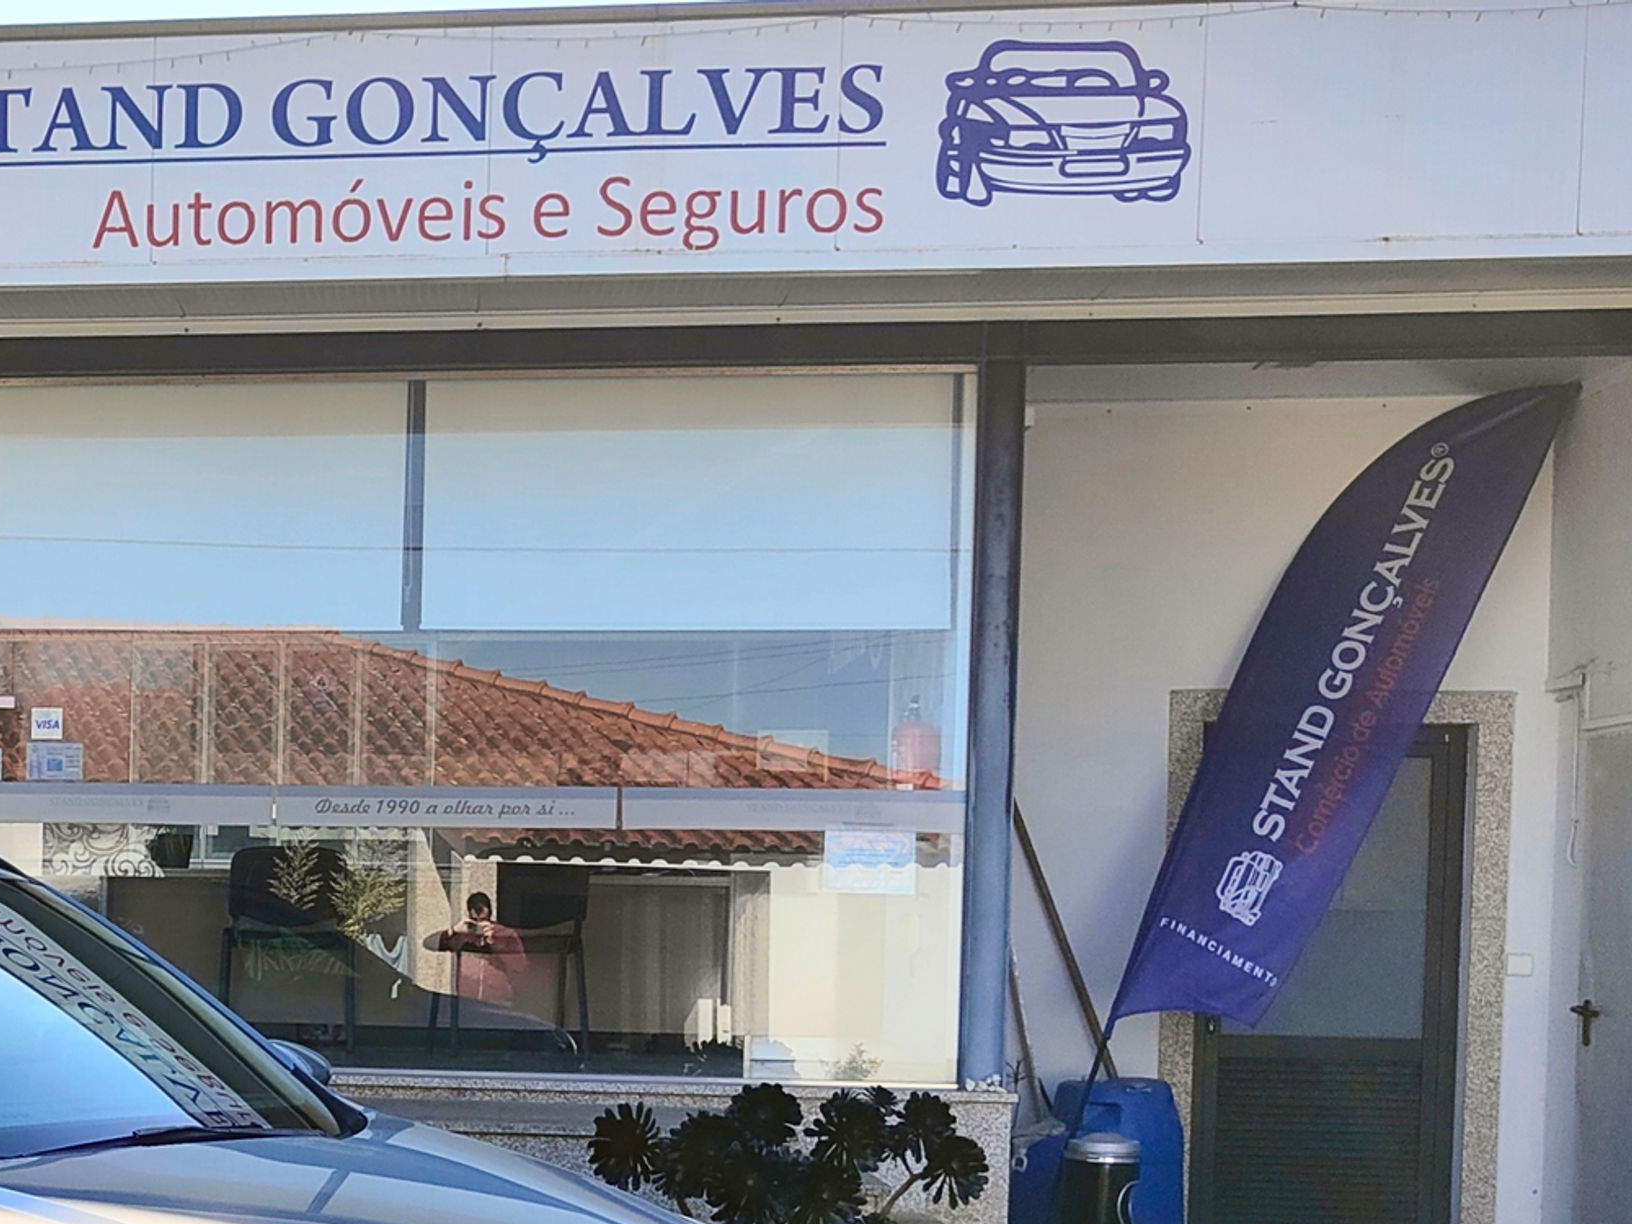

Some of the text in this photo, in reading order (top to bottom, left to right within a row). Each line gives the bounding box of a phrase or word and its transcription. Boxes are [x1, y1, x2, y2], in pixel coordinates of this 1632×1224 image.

[271, 63, 886, 163] GONÇALVES
[93, 175, 886, 251] Automóveis e Seguros
[35, 720, 60, 730] VISA
[1353, 711, 1377, 741] de
[1253, 704, 1335, 842] STAND
[314, 798, 369, 814] Desde
[376, 799, 420, 814] 1990
[425, 804, 438, 815] a
[443, 799, 494, 816] olhar
[498, 803, 531, 819] por
[536, 800, 556, 816] si
